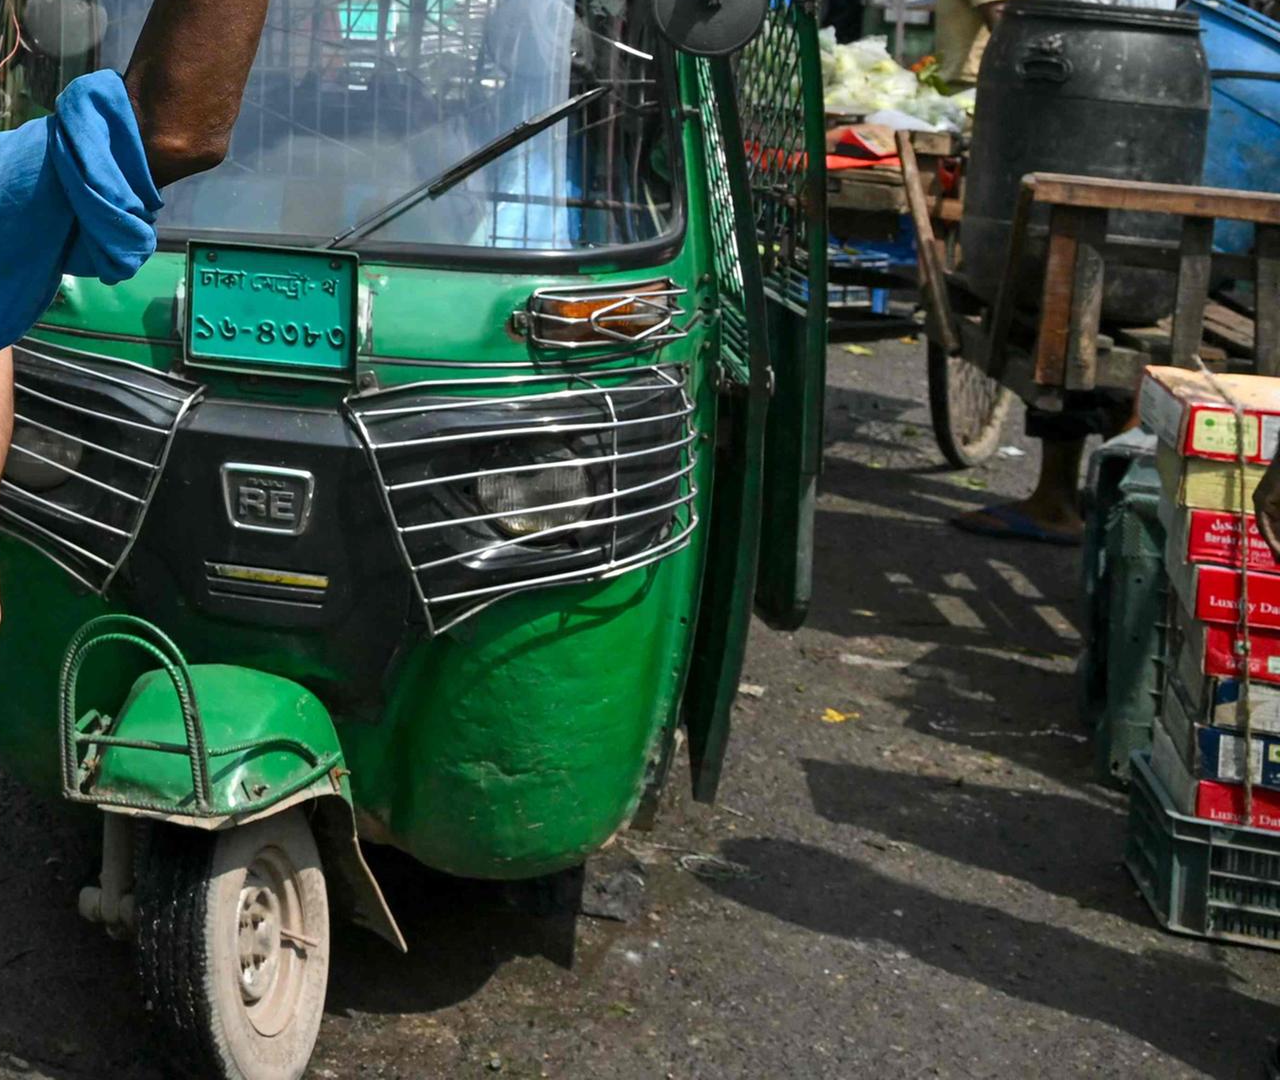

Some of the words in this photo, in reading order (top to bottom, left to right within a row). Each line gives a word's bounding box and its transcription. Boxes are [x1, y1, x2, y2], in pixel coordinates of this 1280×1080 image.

[201, 268, 247, 291] ঢাকা
[196, 314, 347, 350] ১৬-৪৩৮৩
[239, 486, 295, 520] RE
